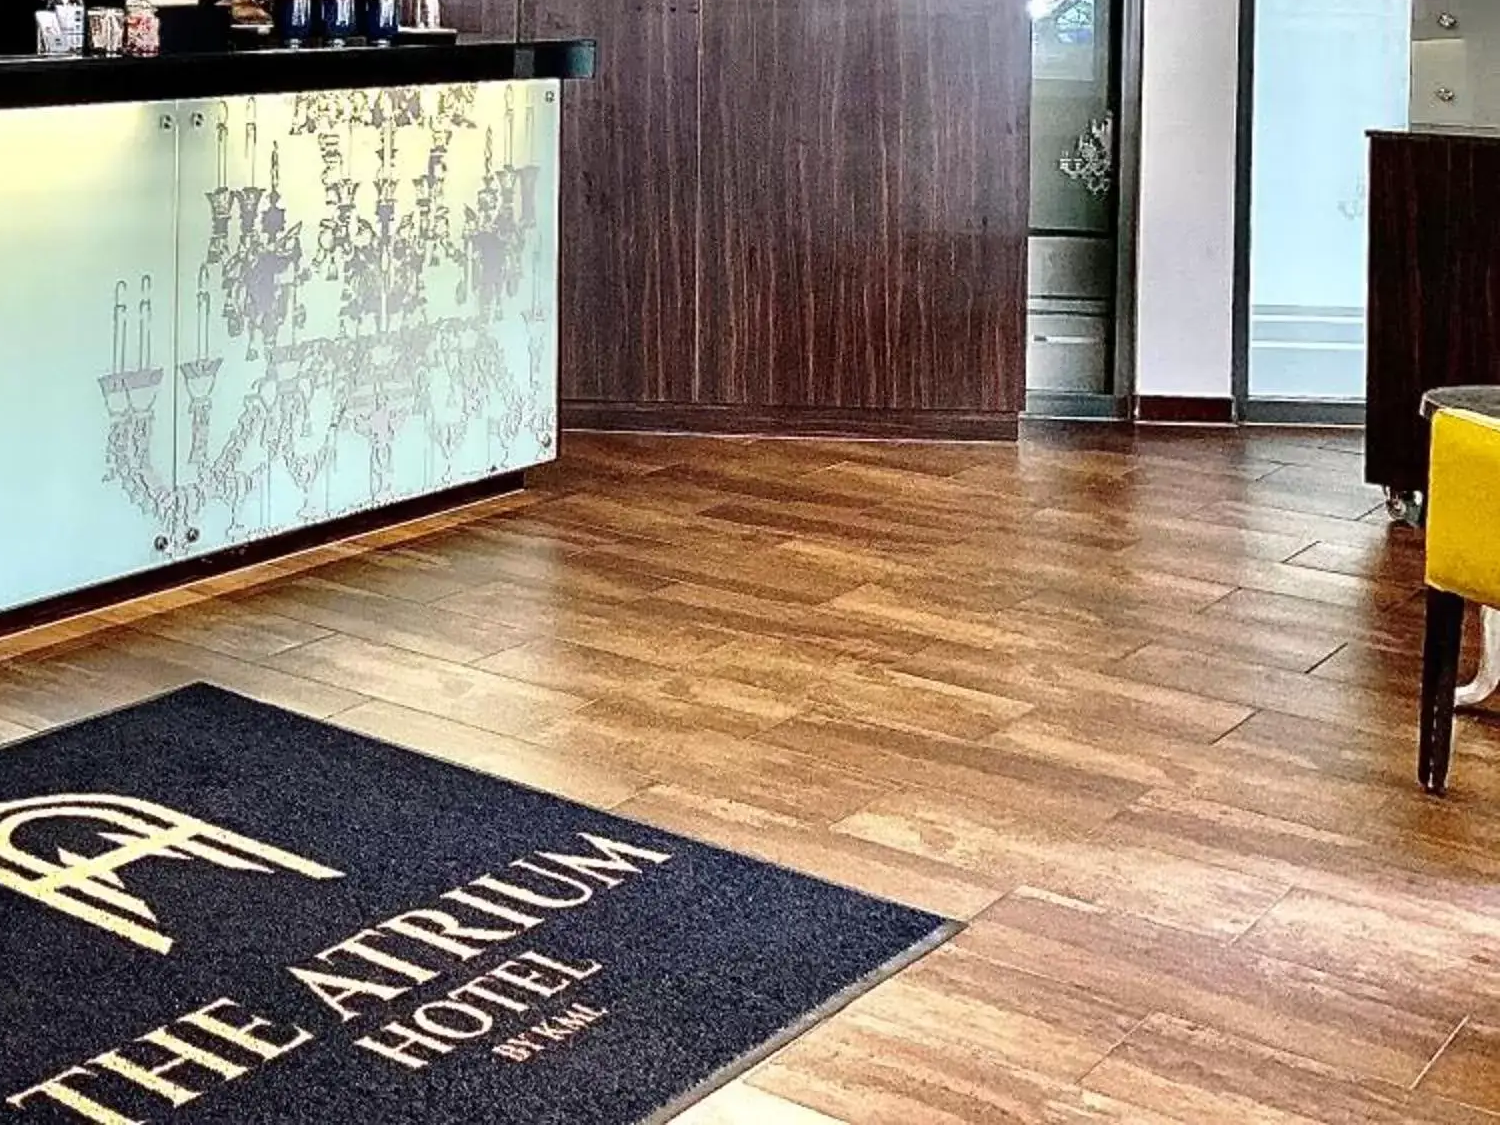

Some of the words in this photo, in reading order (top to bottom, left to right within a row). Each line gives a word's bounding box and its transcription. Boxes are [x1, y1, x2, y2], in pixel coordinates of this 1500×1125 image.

[4, 996, 315, 1125] THE
[285, 831, 674, 1023] ATRIUM
[353, 949, 603, 1070] HOTEL
[491, 1032, 546, 1063] BY
